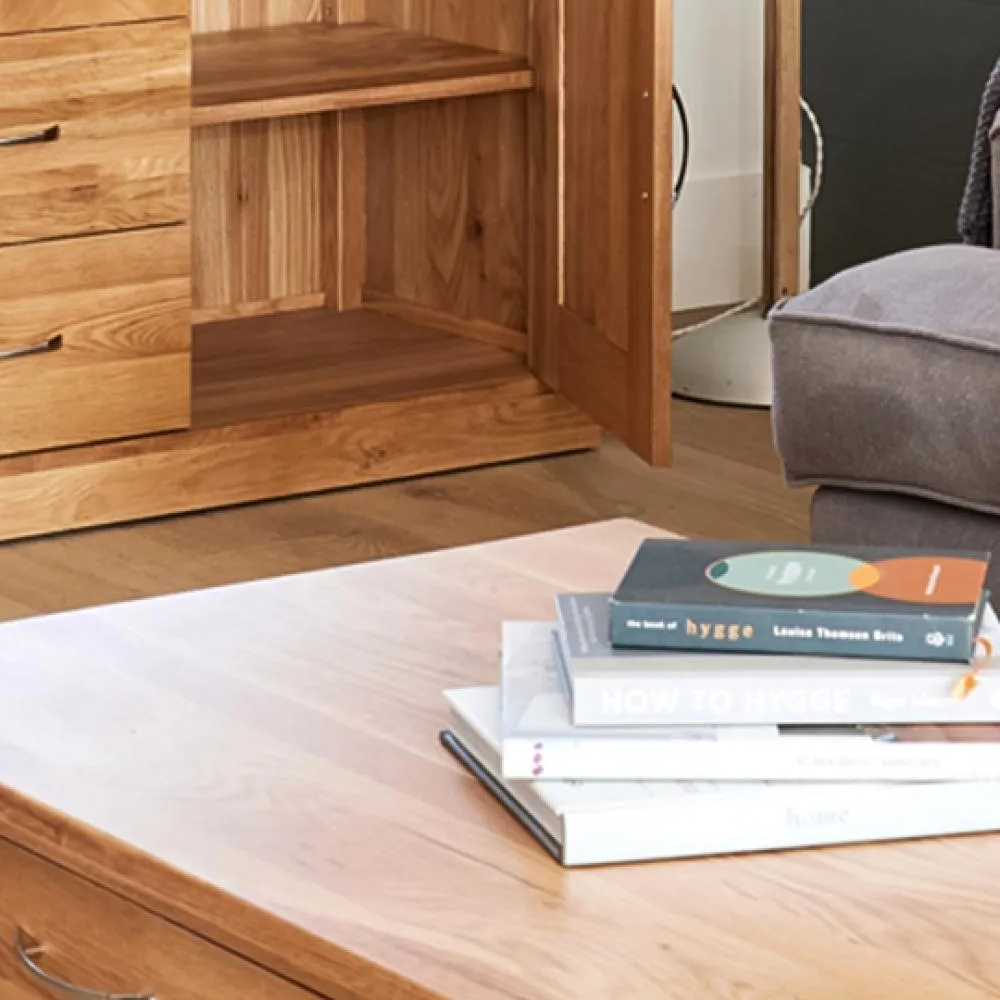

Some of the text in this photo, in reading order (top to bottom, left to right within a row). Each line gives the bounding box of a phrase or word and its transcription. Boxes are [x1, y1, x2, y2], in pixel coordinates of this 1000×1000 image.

[686, 617, 754, 641] hygge
[773, 624, 813, 638] Louise
[601, 687, 851, 714] HOW TO HYGGE
[784, 804, 850, 828] home
